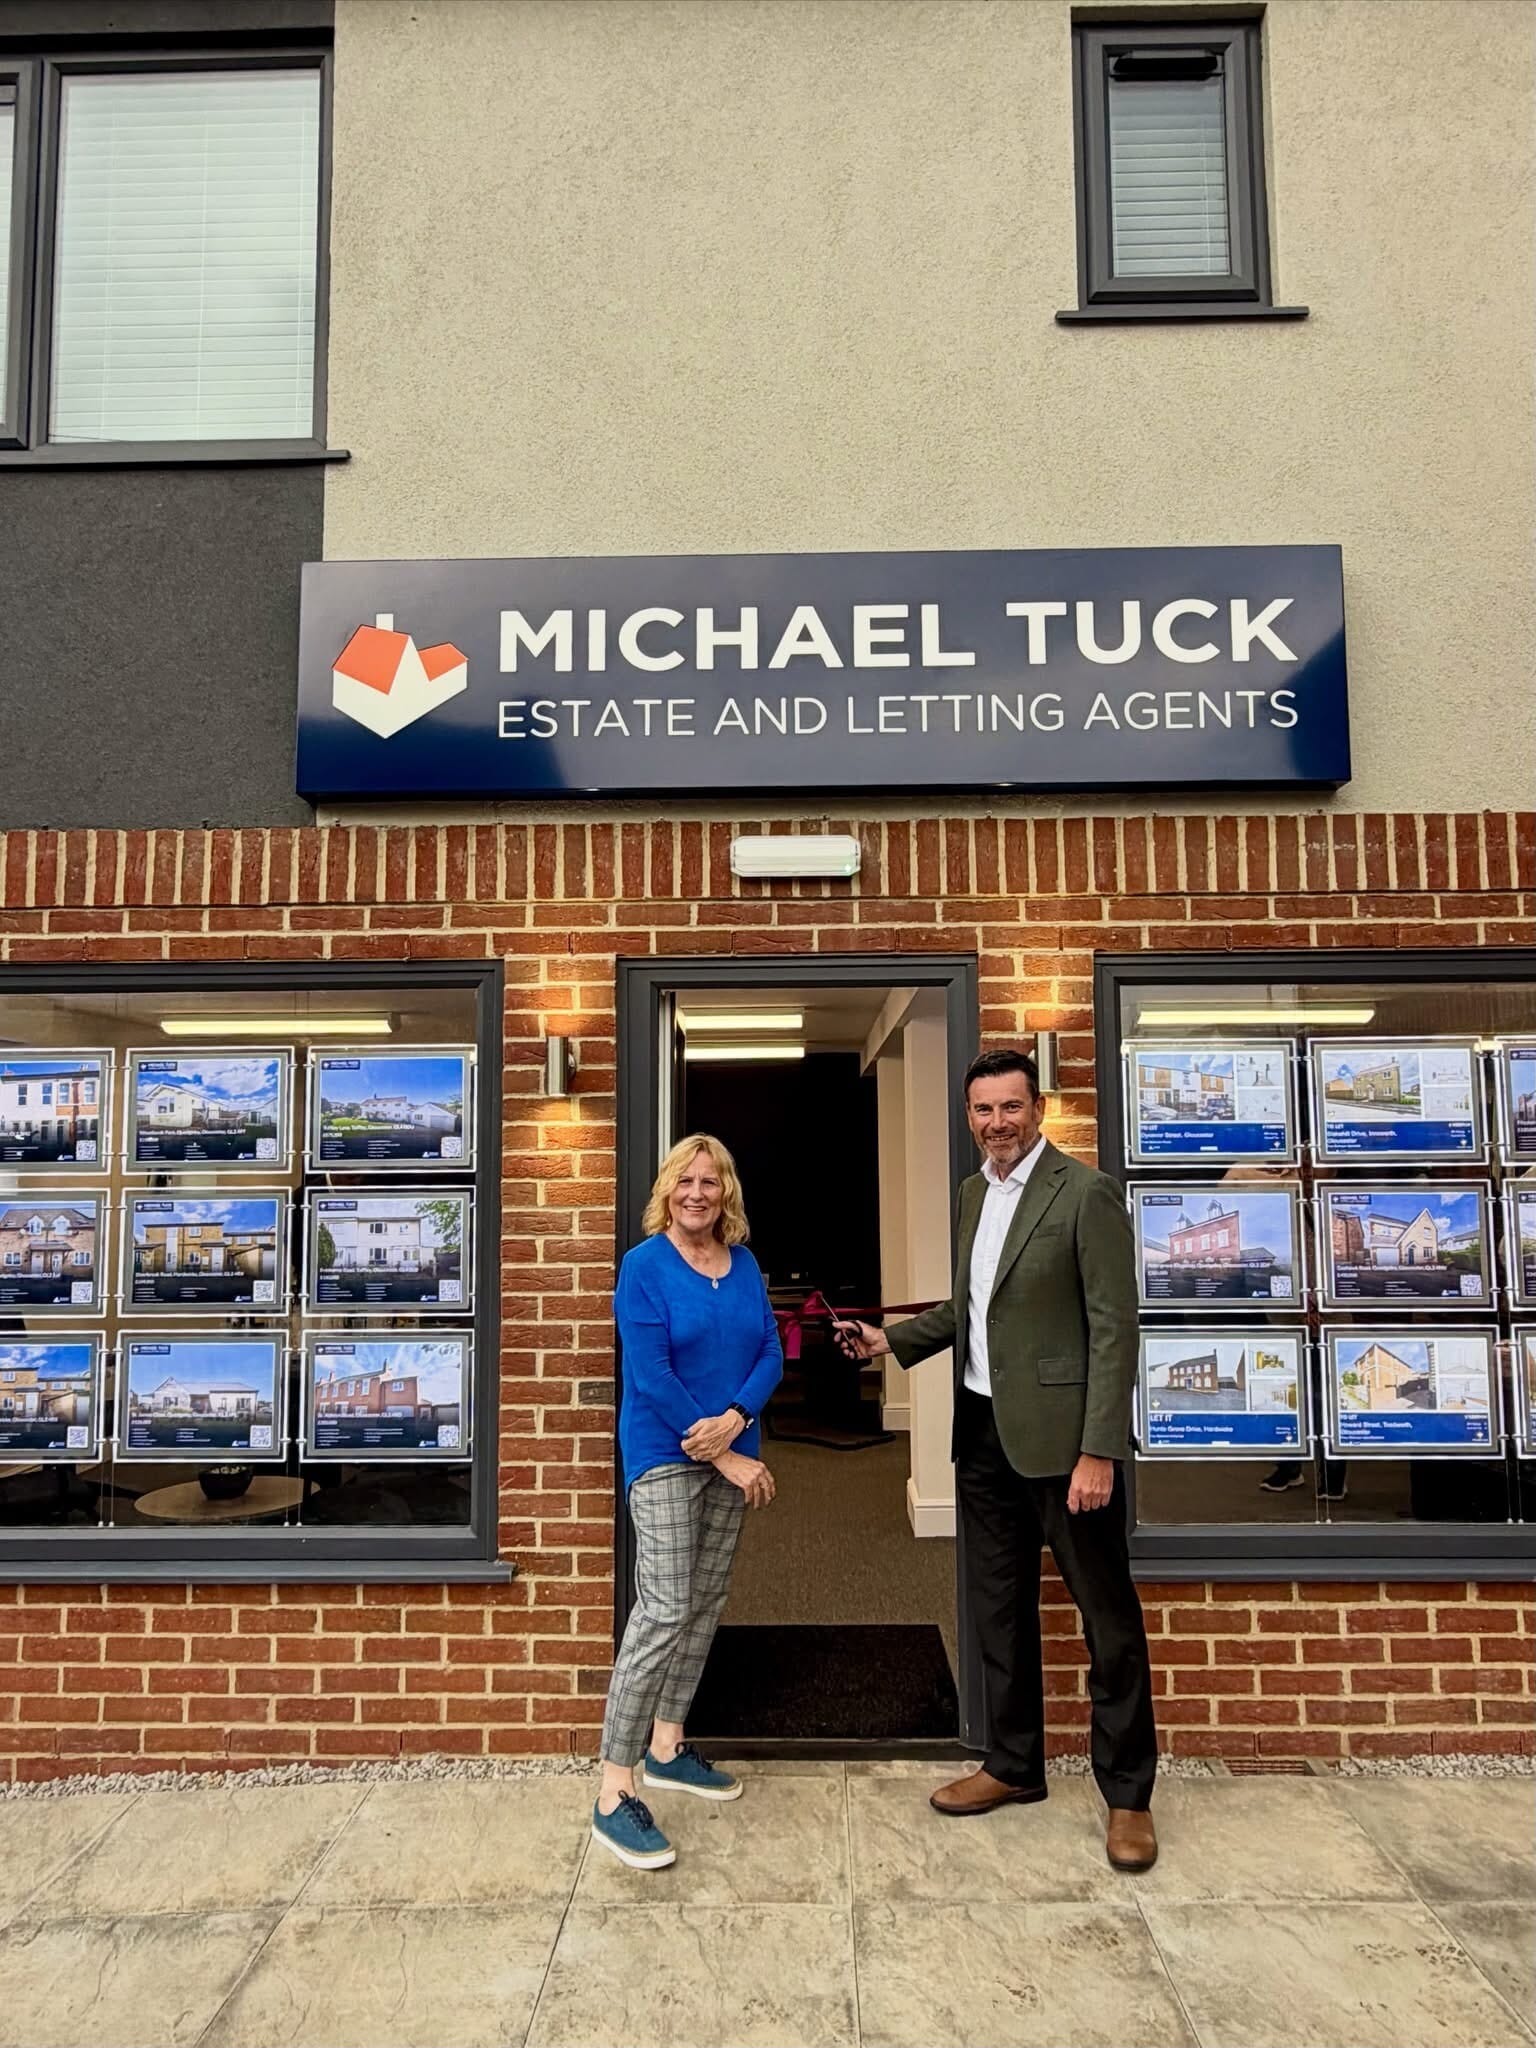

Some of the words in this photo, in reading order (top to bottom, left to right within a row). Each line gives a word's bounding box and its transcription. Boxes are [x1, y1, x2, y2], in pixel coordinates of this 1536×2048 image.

[499, 603, 977, 674] MICHAEL
[1005, 598, 1299, 665] TUCK
[498, 698, 696, 738] ESTATE
[712, 696, 828, 736] AND
[847, 692, 1065, 735] LETTING
[1083, 689, 1298, 731] AGENTS
[1150, 1414, 1163, 1422] LET
[1164, 1414, 1173, 1422] IT
